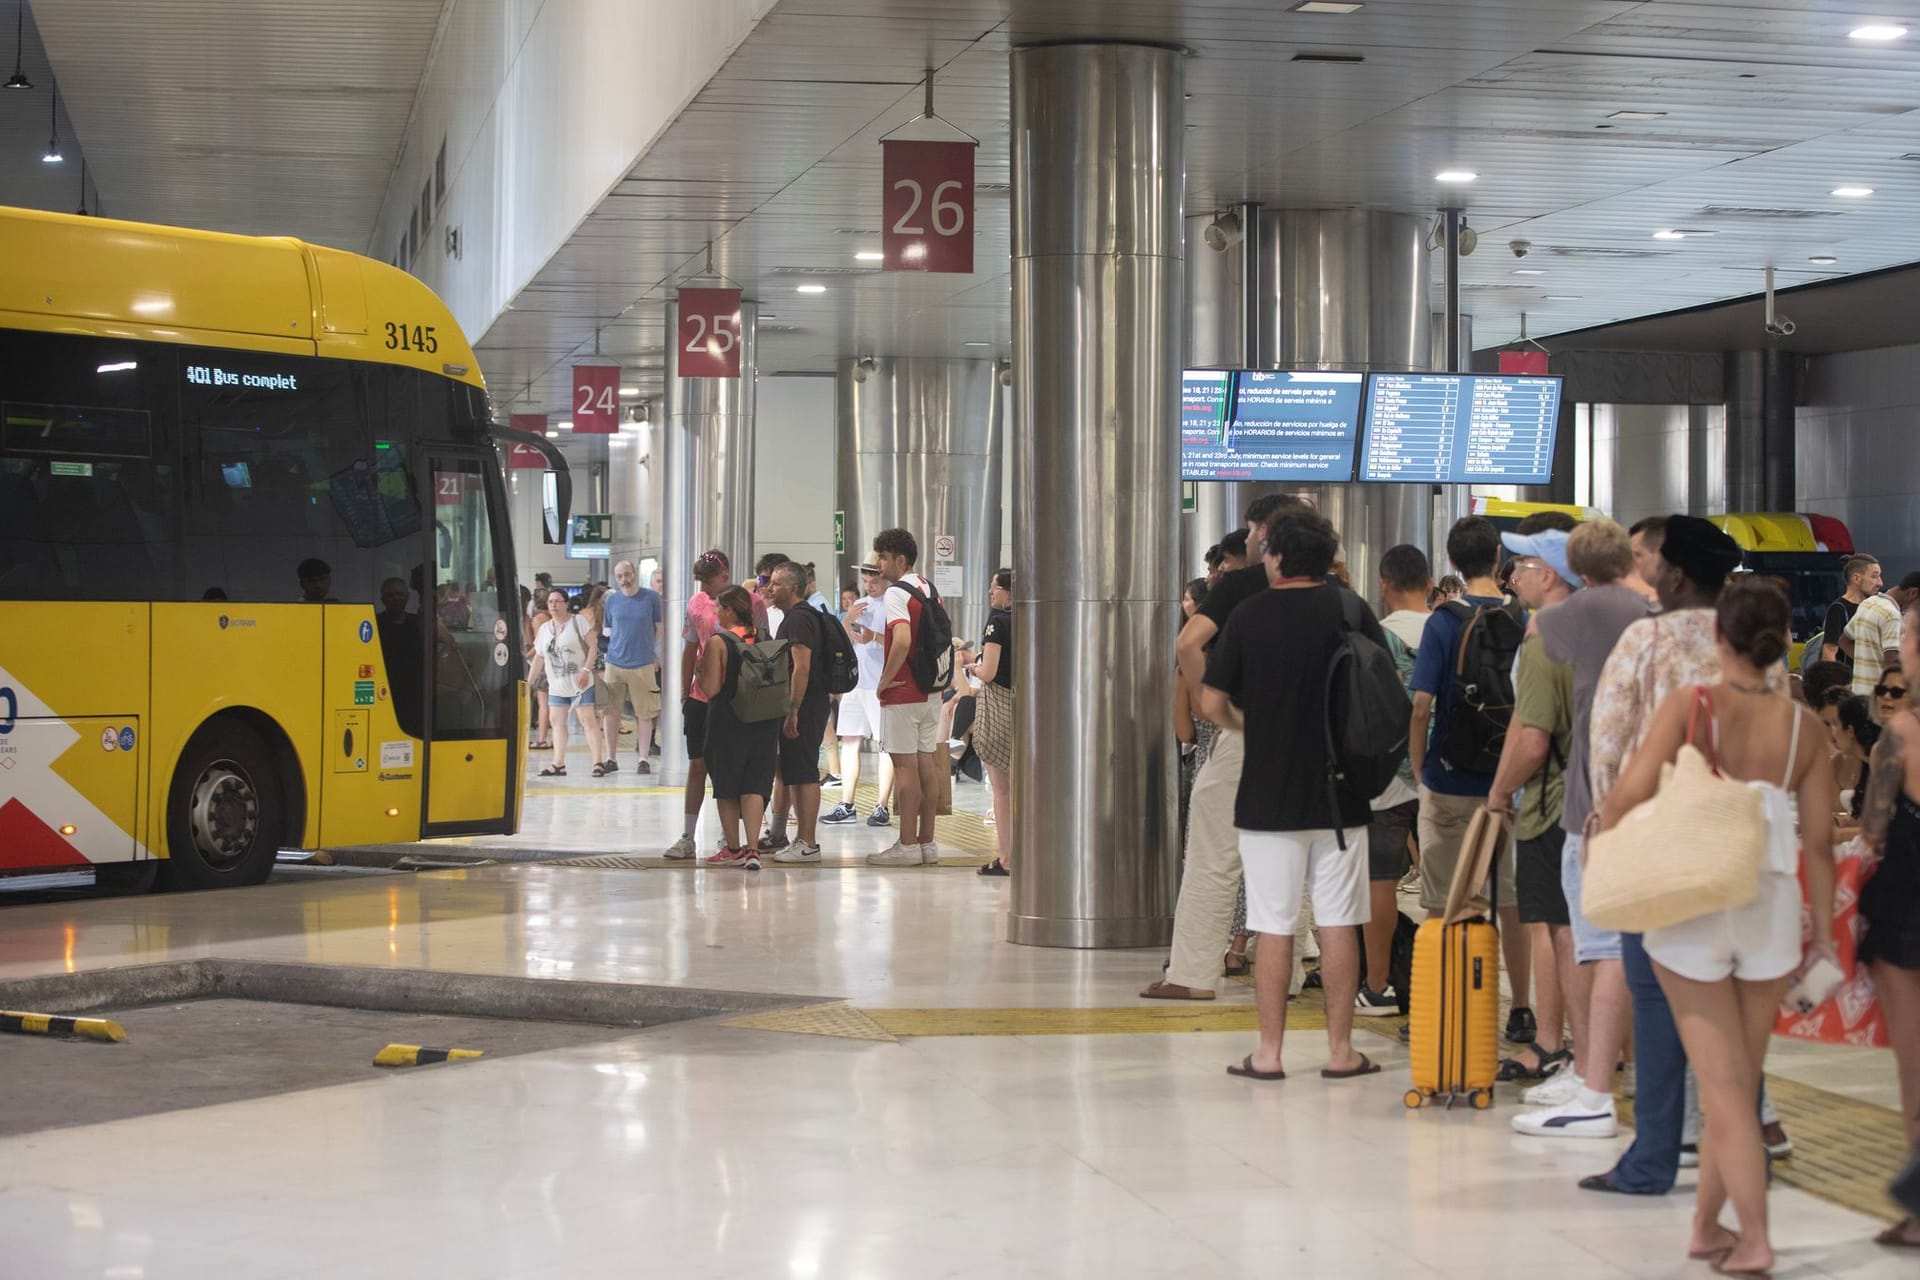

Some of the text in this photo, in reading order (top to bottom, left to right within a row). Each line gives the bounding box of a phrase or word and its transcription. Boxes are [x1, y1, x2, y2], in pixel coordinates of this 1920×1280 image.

[893, 179, 964, 236] 26
[385, 322, 438, 354] 3145
[685, 314, 734, 353] 25
[186, 365, 297, 390] 401 Bus complet
[577, 385, 616, 415] 24
[1273, 387, 1281, 395] de
[1328, 388, 1337, 396] de
[1273, 420, 1282, 428] de
[1282, 420, 1308, 428] servicios
[1318, 421, 1339, 429] huelga
[1284, 429, 1310, 437] servicios
[1318, 452, 1341, 461] general
[439, 477, 460, 496] 21
